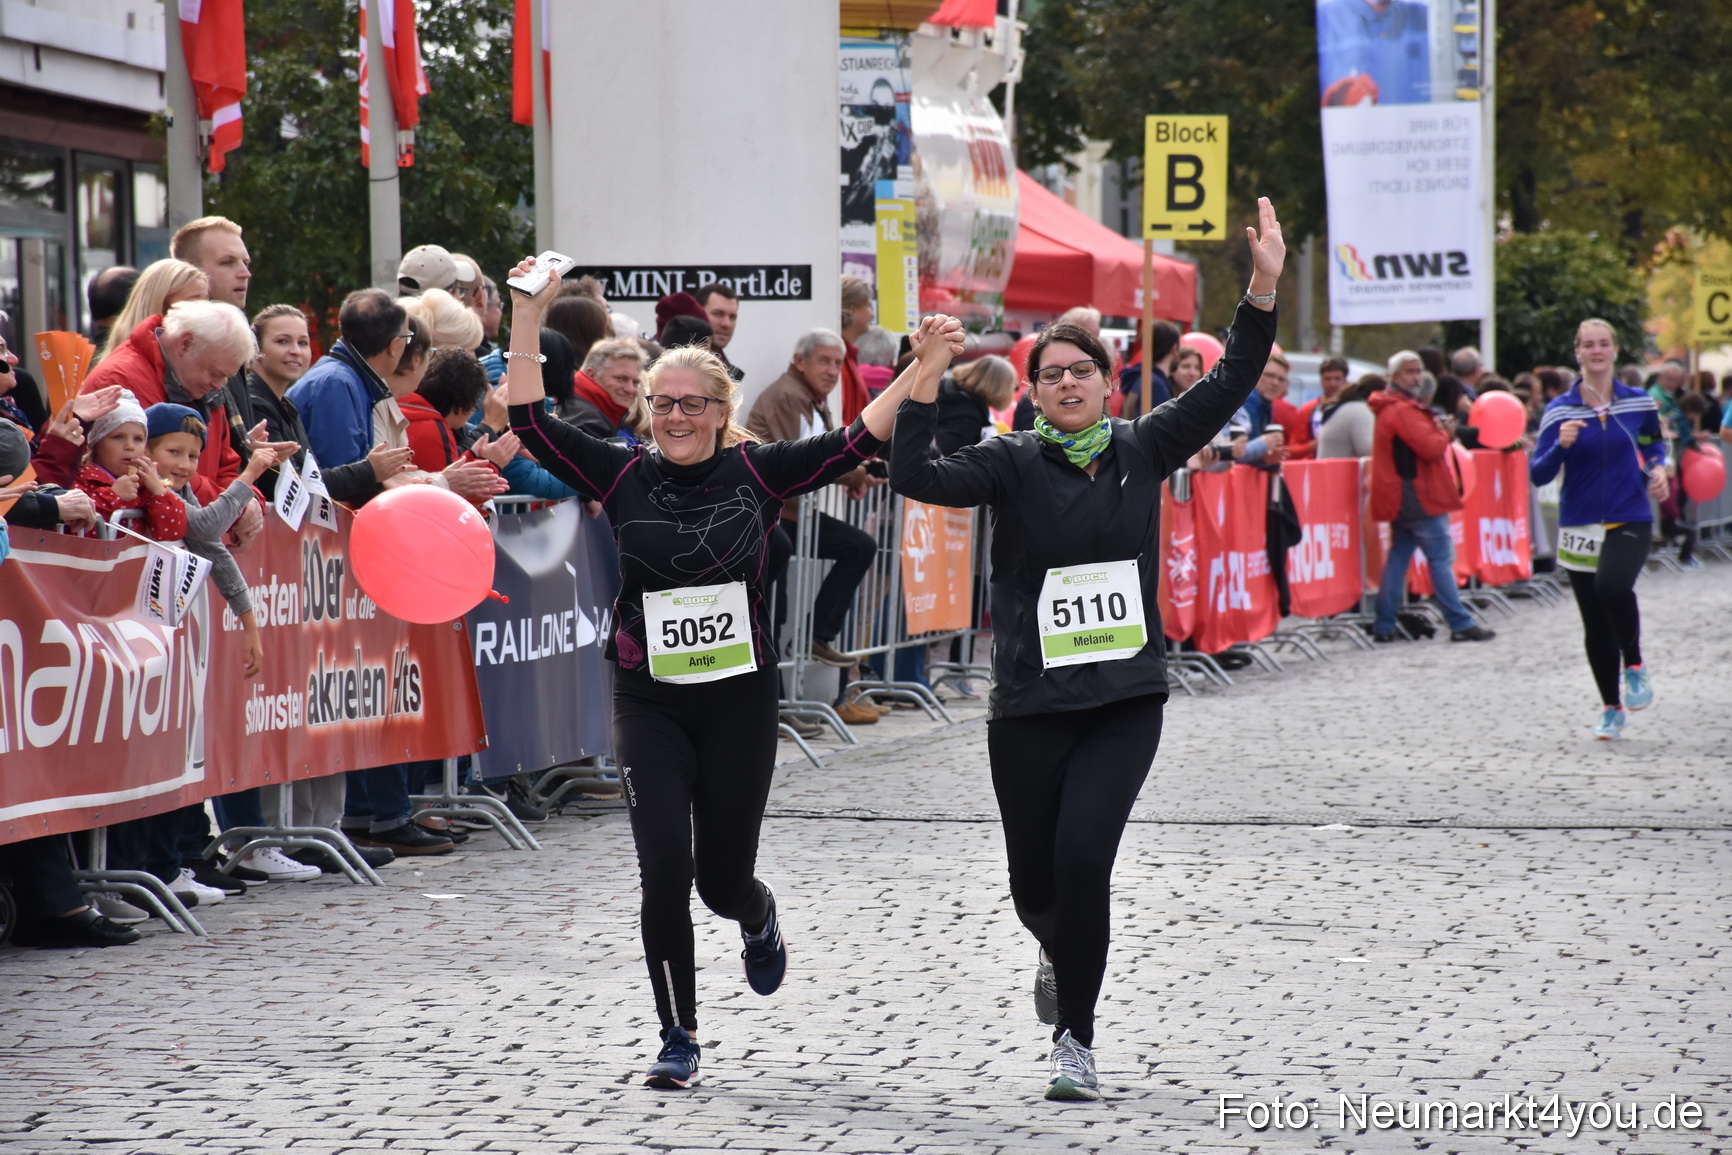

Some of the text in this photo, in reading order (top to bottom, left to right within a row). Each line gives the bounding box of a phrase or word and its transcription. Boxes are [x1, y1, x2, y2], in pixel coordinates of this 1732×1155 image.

[1156, 121, 1217, 143] Block
[1166, 154, 1205, 212] B
[1707, 291, 1730, 325] C
[1562, 532, 1595, 553] 5174
[1073, 572, 1107, 583] BOCK
[683, 595, 717, 605] BOCK
[1052, 592, 1127, 628] 5110
[662, 612, 735, 648] 5052
[1073, 633, 1115, 647] Melanie
[689, 655, 716, 667] Antje
